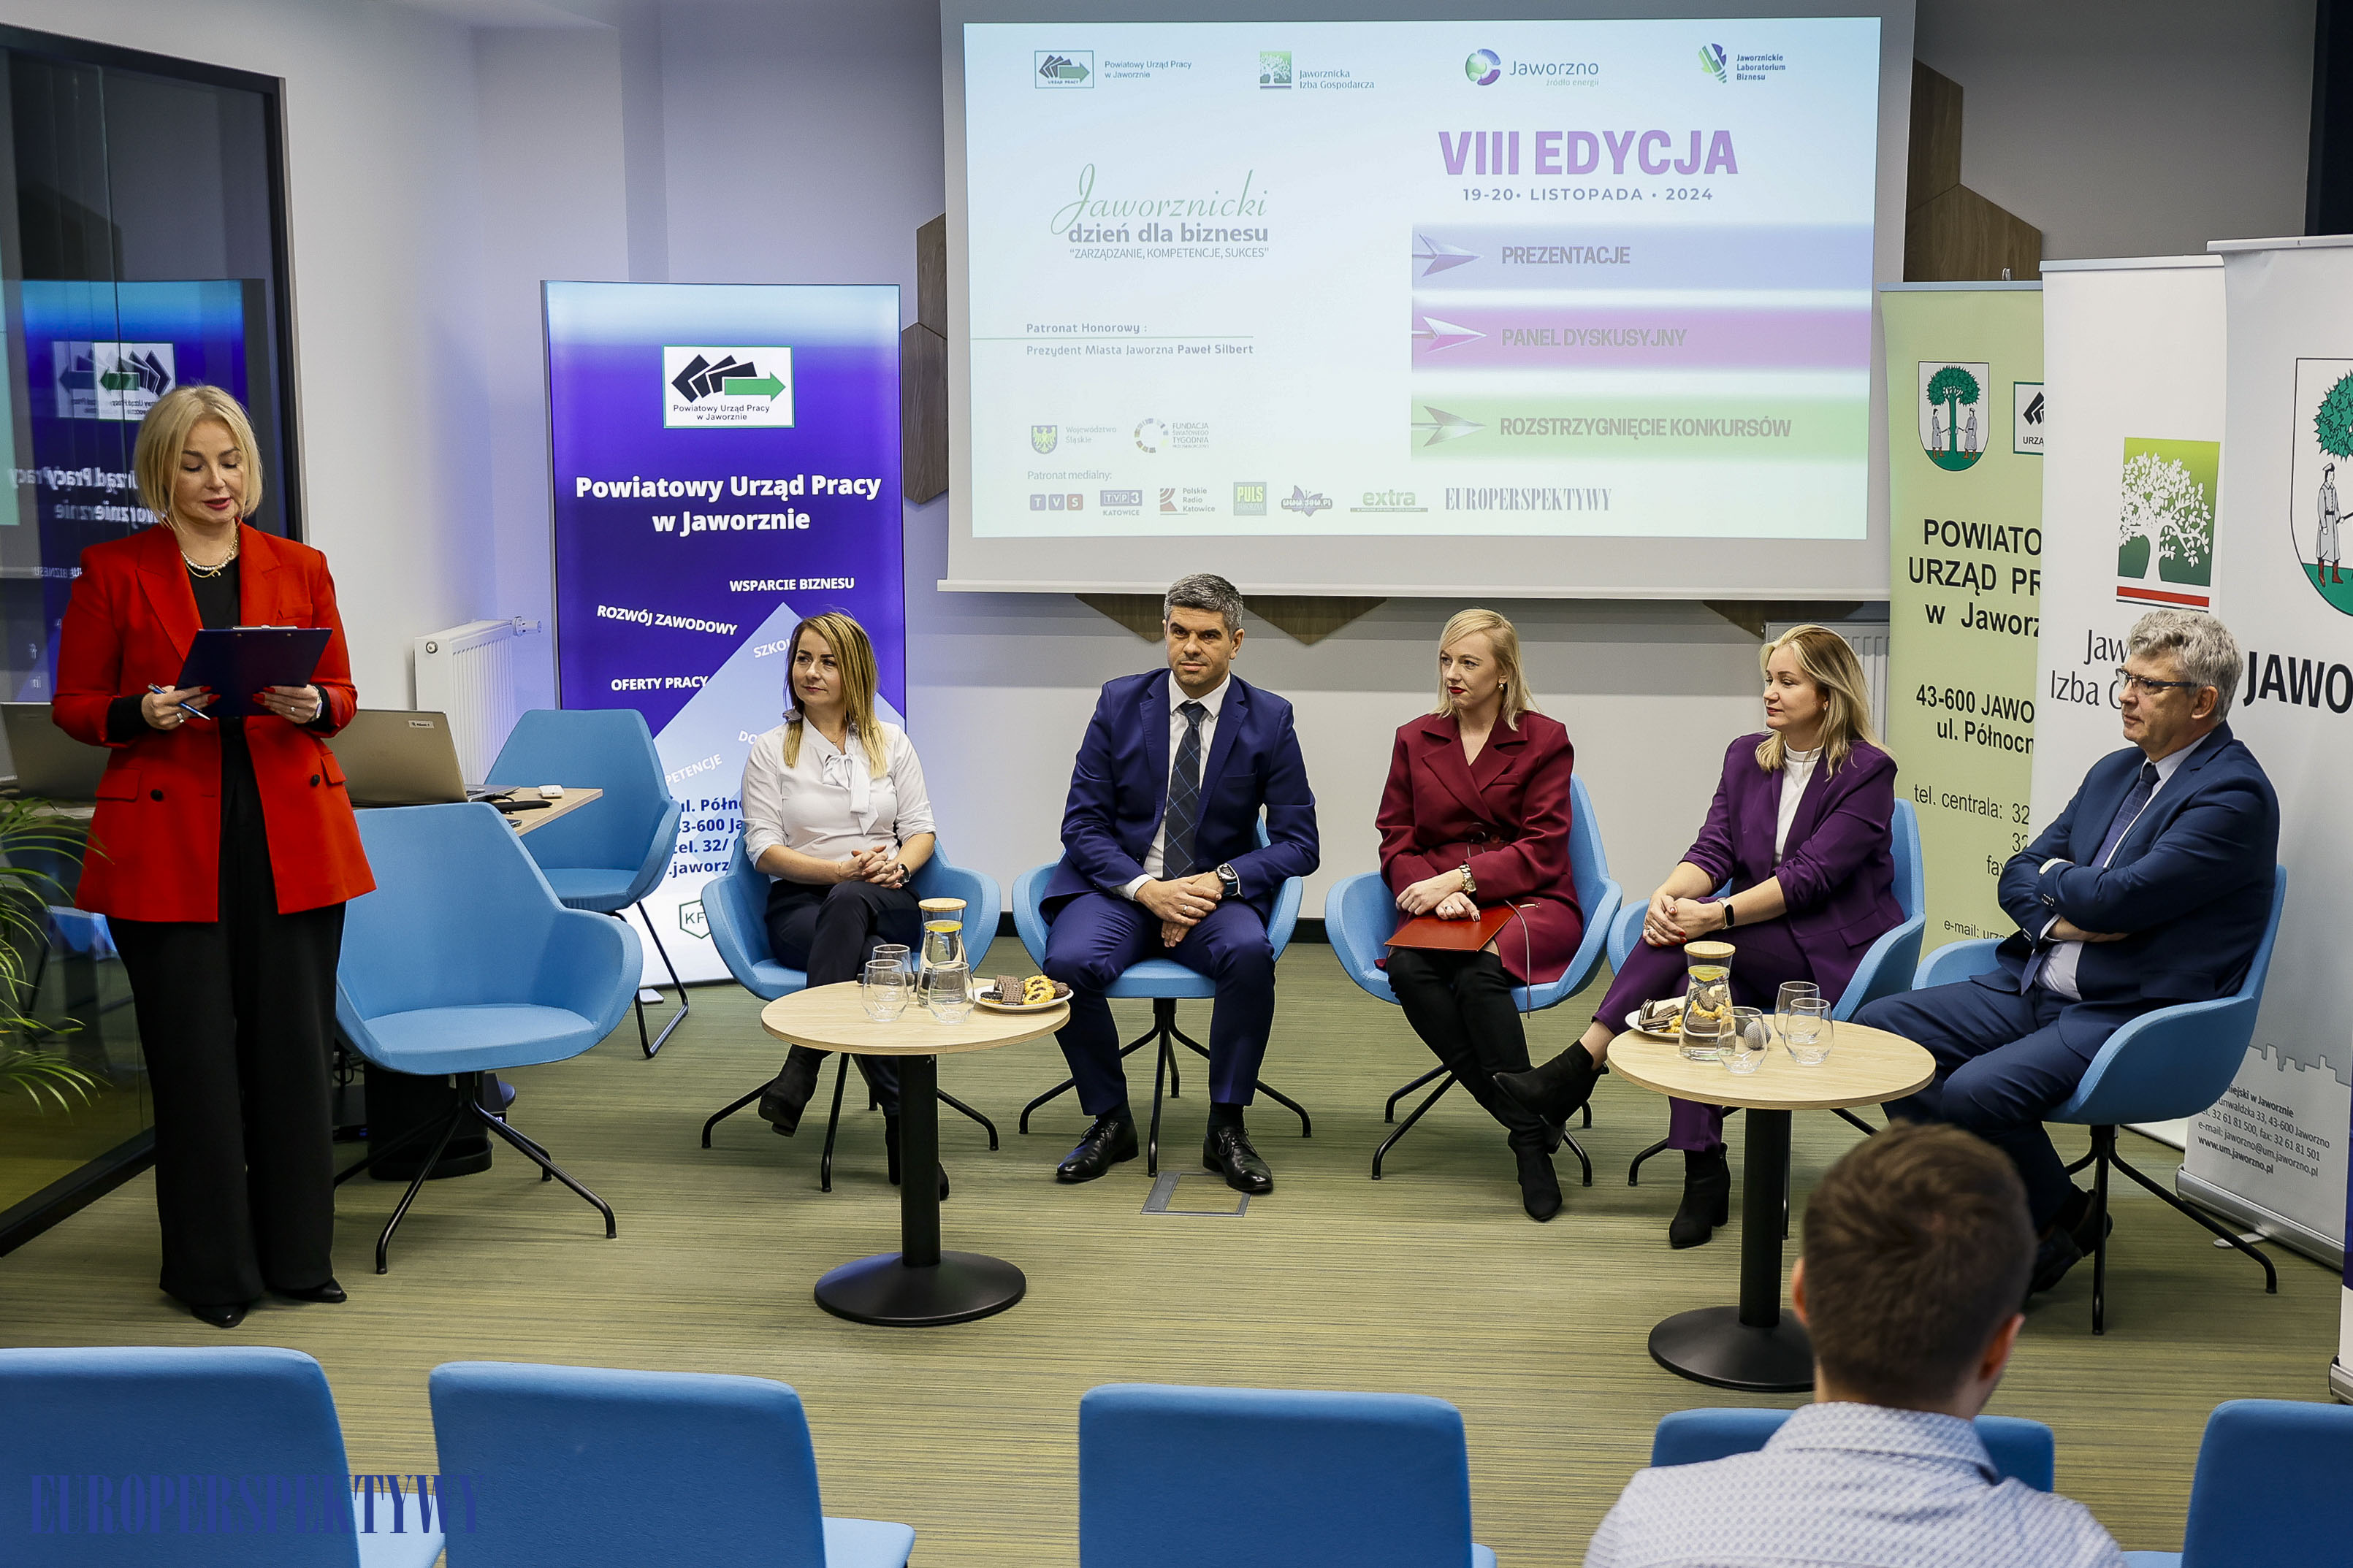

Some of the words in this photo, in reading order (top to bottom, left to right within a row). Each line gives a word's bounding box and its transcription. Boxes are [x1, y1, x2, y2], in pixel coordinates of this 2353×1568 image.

[1105, 61, 1144, 69] Powiatowy
[1147, 61, 1169, 70] Urząd
[1170, 61, 1192, 69] Pracy
[1300, 70, 1350, 79] Jaworznicka
[1509, 61, 1598, 76] Jaworzno
[1300, 81, 1317, 89] Izba
[1320, 80, 1375, 90] Gospodarcza
[1573, 79, 1599, 88] energii
[1438, 131, 1519, 175] VIII
[1536, 130, 1739, 175] EDYCJA
[1050, 164, 1268, 235] Jaworznicki
[1531, 188, 1644, 201] LISTOPADA
[1666, 188, 1713, 200] 2024
[1068, 223, 1130, 242] dzień
[1138, 223, 1173, 242] dla
[1181, 222, 1268, 242] biznesu
[1147, 248, 1223, 259] KOMPETENCJE,
[1502, 246, 1631, 264] PREZENTACJE
[1026, 324, 1078, 333] Patronat
[1082, 323, 1140, 334] Honorowy
[1501, 329, 1561, 346] PANEL
[1564, 329, 1687, 347] DYSKUSYJNY
[1026, 345, 1081, 357] Prezydent
[1086, 345, 1122, 355] Miasta
[1126, 345, 1173, 356] Jaworzna
[1178, 345, 1211, 355] Paweł
[1215, 345, 1254, 355] Silbert
[674, 405, 718, 413] Powiatowy
[720, 405, 744, 413] Urząd
[747, 405, 770, 413] Pracy
[1066, 427, 1116, 435] Województwo
[1500, 417, 1666, 440] ROZSTRZYGNIĘCIE
[1671, 416, 1791, 437] KONKURSÓW
[1066, 436, 1092, 444] Śląskie
[1027, 471, 1066, 481] Patronat
[1068, 470, 1113, 482] medialny:
[576, 475, 724, 502] Powiatowy
[731, 475, 804, 502] Urząd
[812, 475, 882, 501] Pracy
[1237, 486, 1264, 502] PULS
[1363, 489, 1416, 506] extra
[1445, 488, 1612, 511] EUROPERSPEKTYWY
[652, 515, 675, 532] w
[680, 508, 811, 538] Jaworznie
[1924, 519, 2042, 556] POWIATO
[730, 579, 796, 592] WSPARCIE
[799, 578, 855, 590] BIZNESU
[1909, 557, 1997, 597] URZĄD
[597, 605, 653, 627] ROZWÓJ
[655, 613, 737, 635] ZAWODOWY
[1925, 604, 1946, 625] w
[611, 678, 663, 691] OFERTY
[666, 676, 709, 689] PRACY
[2051, 670, 2100, 706] Izba
[2243, 651, 2353, 714] JAWO
[1916, 684, 1975, 714] 43-600
[1981, 694, 2035, 724] JAWO
[1937, 718, 1958, 741] ul.
[1914, 784, 1936, 806] tel.
[1942, 793, 2003, 819] centrala:
[2012, 803, 2030, 825] 32
[678, 819, 725, 833] 3-600
[703, 839, 729, 853] 32/
[1944, 920, 1980, 938] e-mail:
[2250, 1094, 2257, 1103] w
[2258, 1095, 2294, 1118] Jaworznie
[2212, 1109, 2222, 1121] 32
[2223, 1113, 2232, 1125] 61
[2233, 1117, 2242, 1129] 81
[2244, 1123, 2258, 1137] 500,
[2274, 1134, 2283, 1146] 32
[2285, 1139, 2294, 1151] 61
[2295, 1144, 2305, 1155] 81
[2307, 1148, 2321, 1162] 501
[2269, 1117, 2293, 1134] 43-600
[2295, 1127, 2330, 1149] Jaworzno
[2197, 1120, 2224, 1138] e-mail:
[2224, 1129, 2319, 1177] jaworzno@um.jaworzno.pl
[2198, 1136, 2274, 1174] www.um.jaworzno.pl
